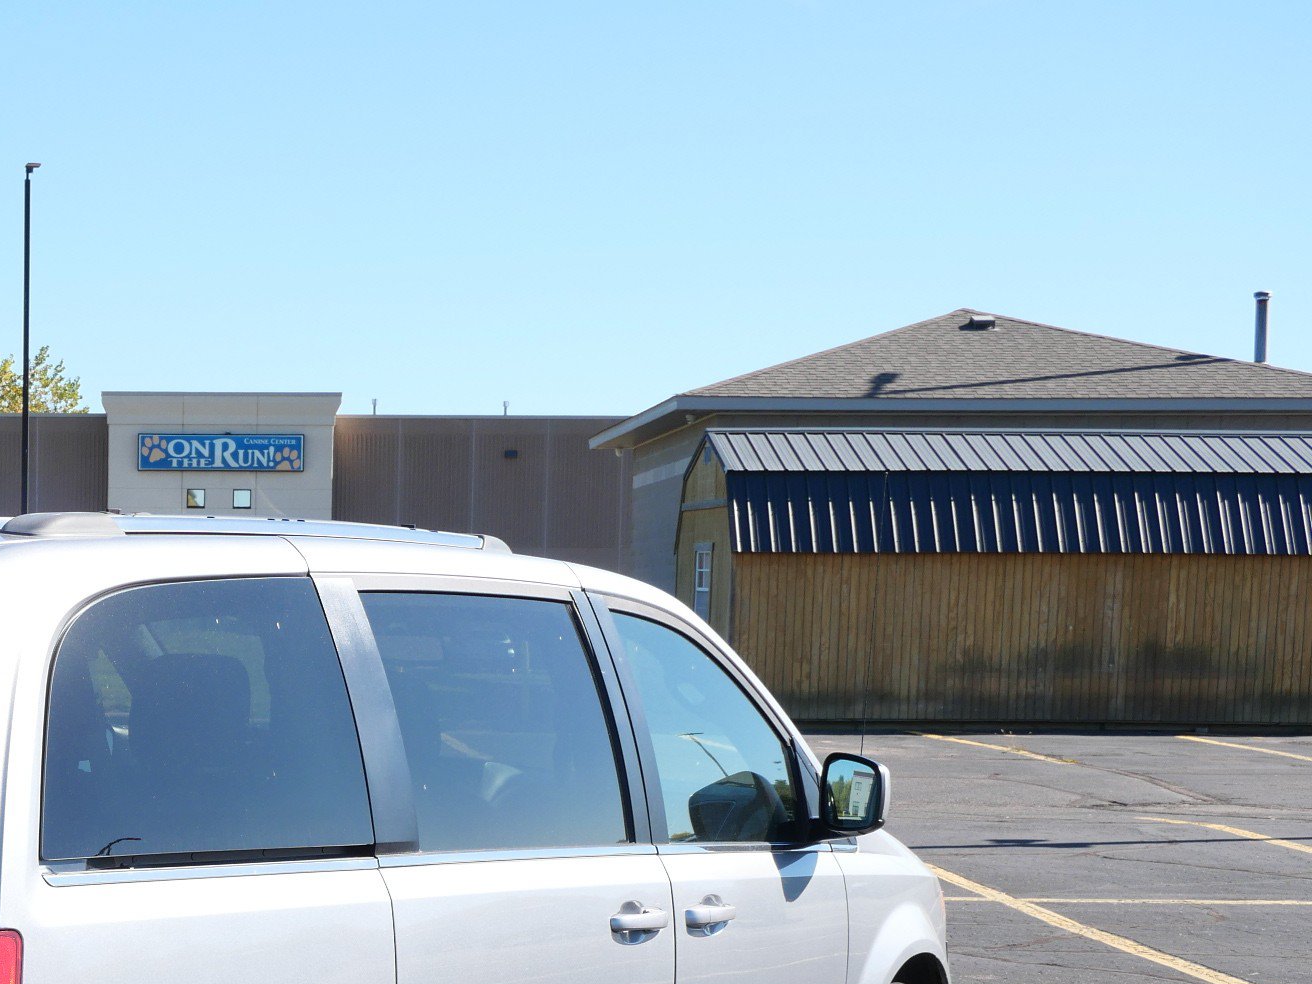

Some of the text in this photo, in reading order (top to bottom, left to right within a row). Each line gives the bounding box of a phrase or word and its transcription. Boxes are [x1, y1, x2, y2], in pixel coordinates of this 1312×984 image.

[168, 439, 211, 457] ON
[168, 438, 275, 468] THE RUN!
